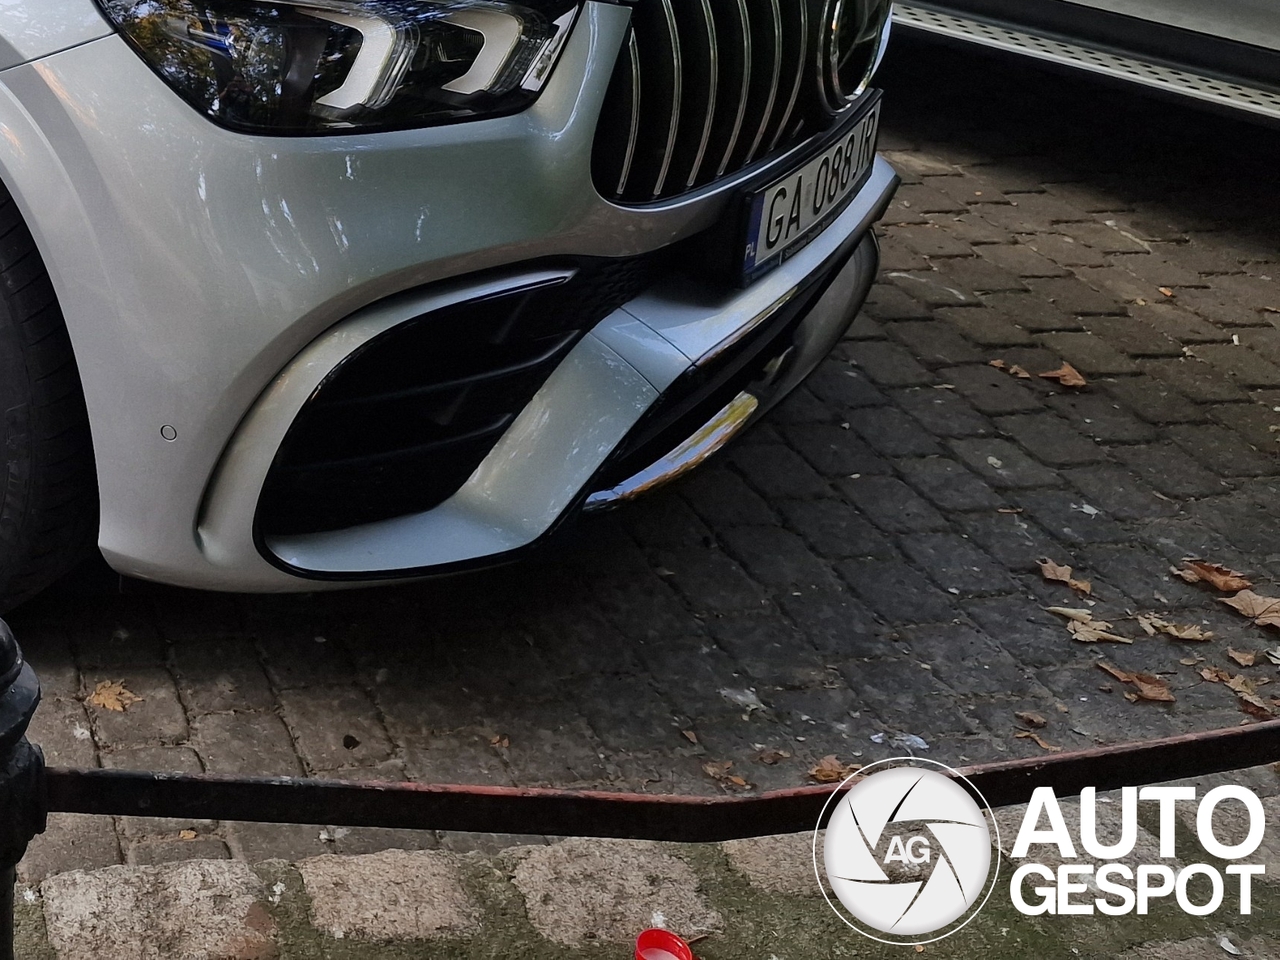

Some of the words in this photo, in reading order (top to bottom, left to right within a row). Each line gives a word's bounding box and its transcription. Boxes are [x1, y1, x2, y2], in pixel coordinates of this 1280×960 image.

[766, 175, 802, 249] GA
[812, 109, 876, 216] 088JR
[745, 242, 756, 261] PL
